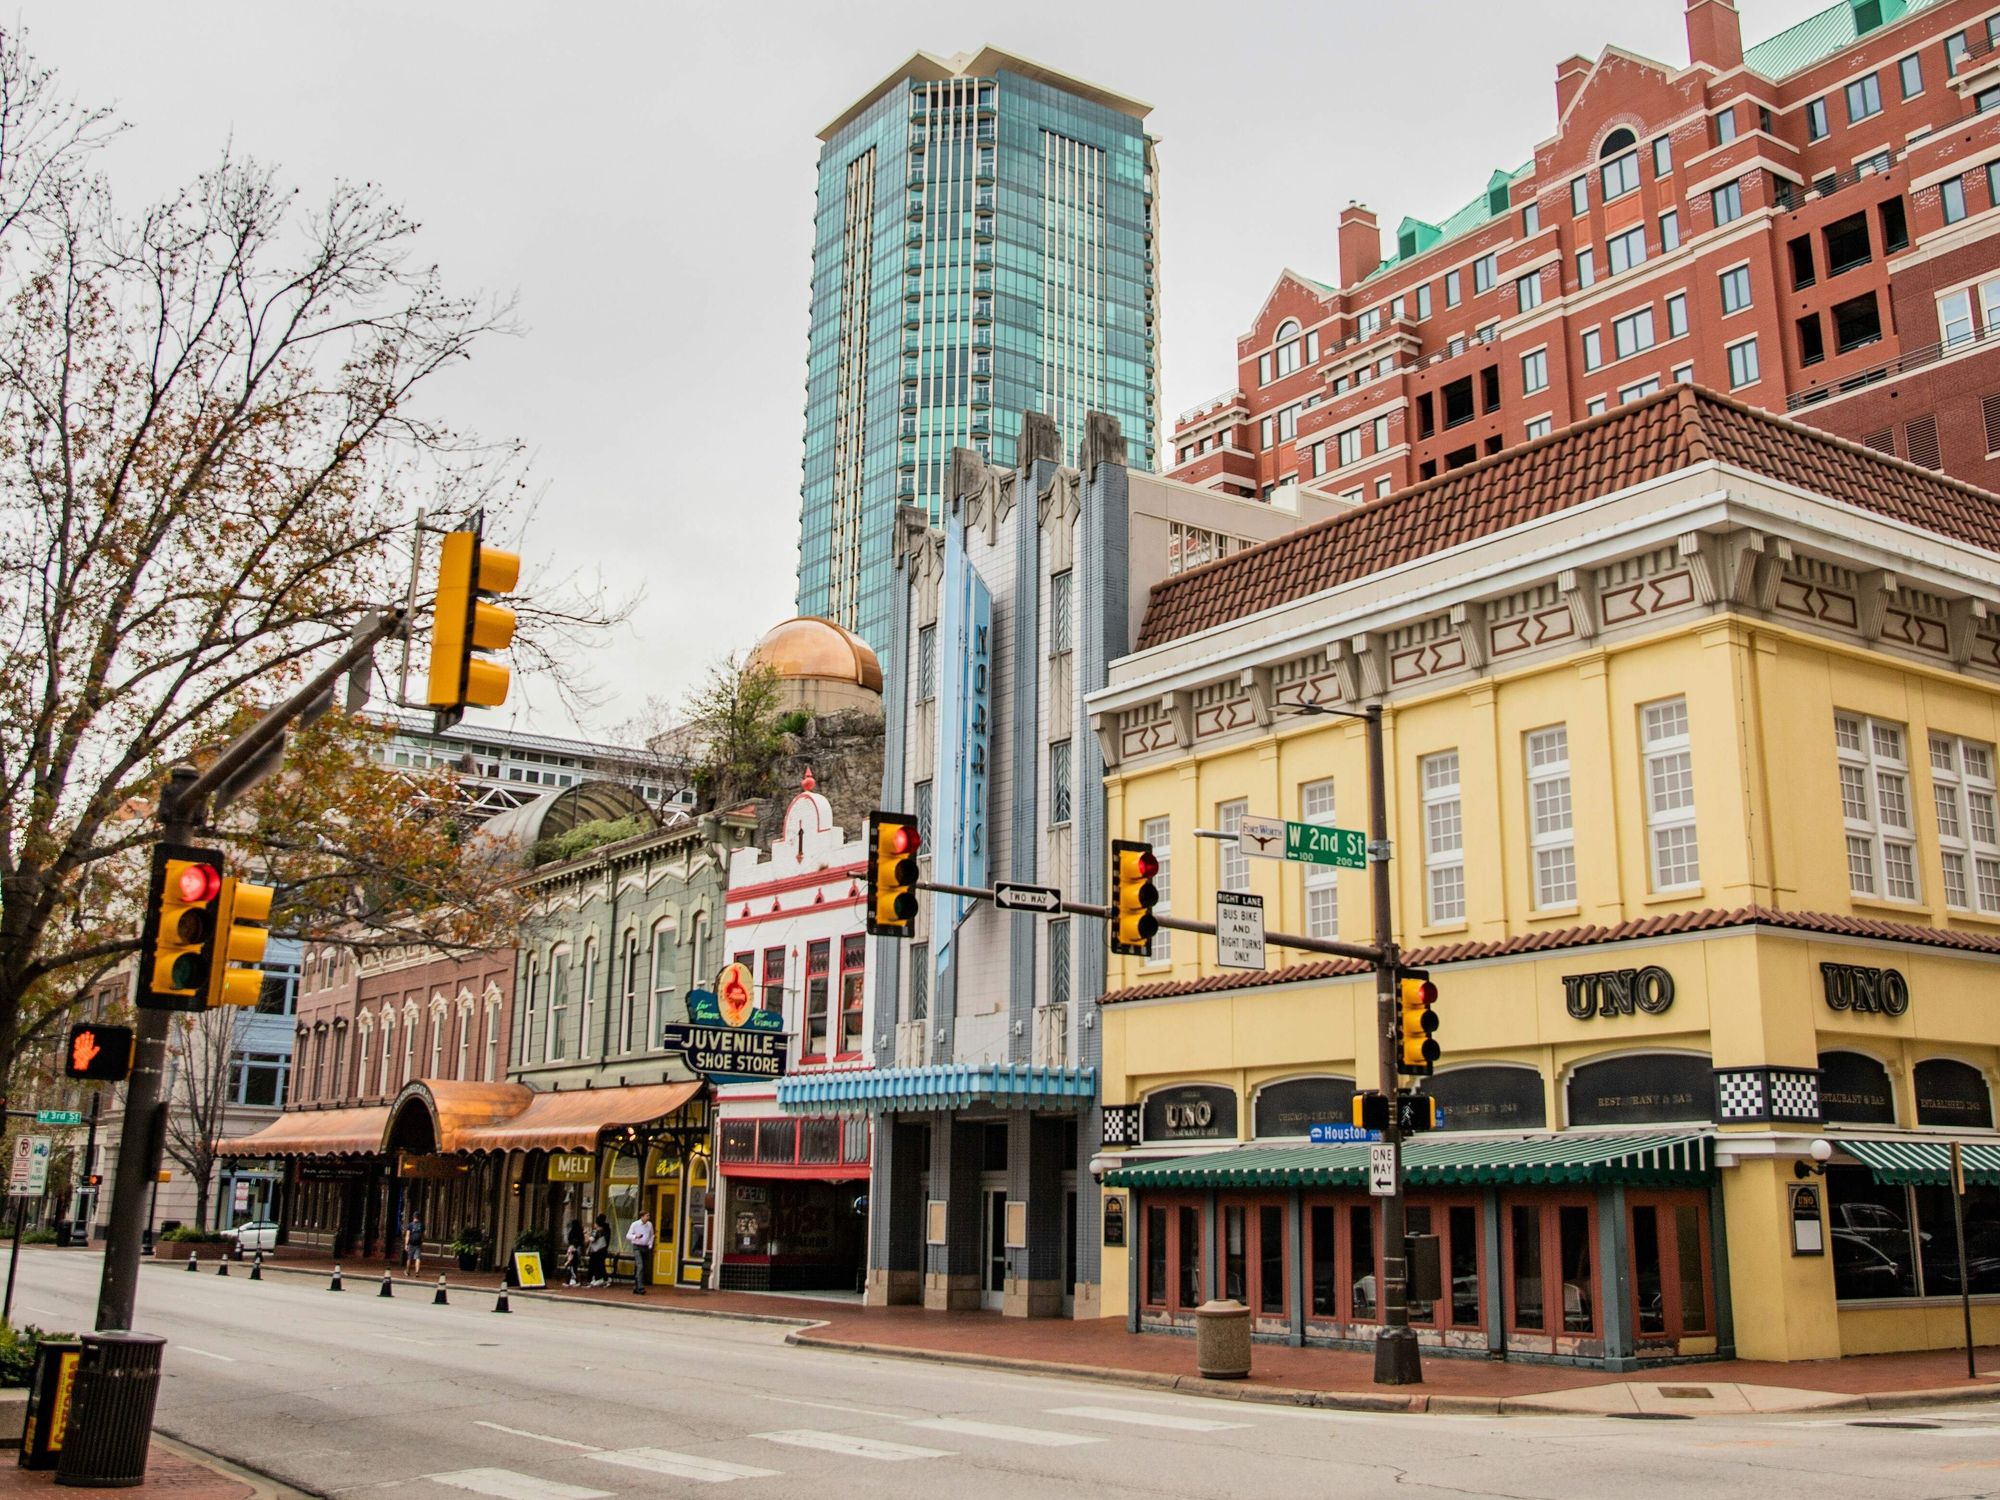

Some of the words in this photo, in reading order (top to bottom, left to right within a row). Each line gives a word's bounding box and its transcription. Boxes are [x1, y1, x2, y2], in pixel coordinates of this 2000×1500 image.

[971, 624, 988, 855] NORRIS
[1289, 825, 1301, 848] W
[1309, 828, 1338, 852] 2nd
[1347, 834, 1364, 856] St
[1300, 852, 1314, 861] 100
[1336, 857, 1352, 866] 200
[1010, 892, 1026, 902] TWO
[1031, 896, 1047, 904] WAY
[1218, 894, 1238, 904] RIGHT
[1242, 896, 1262, 906] LANE
[1223, 909, 1238, 919] BUS
[1241, 911, 1258, 922] BIKE
[1232, 925, 1250, 934] AND
[1221, 937, 1240, 949] RIGHT
[1242, 939, 1262, 951] TURNS
[1234, 950, 1250, 962] ONLY
[1562, 965, 1675, 1020] UNO
[1820, 962, 1909, 1017] UNO
[681, 1029, 774, 1055] JUVENILE
[696, 1051, 732, 1070] SHOE
[737, 1055, 779, 1073] STORE
[50, 1111, 66, 1120] 3rd
[70, 1112, 79, 1120] St
[1165, 1101, 1212, 1129] UNO
[1324, 1125, 1367, 1140] Houston
[1373, 1149, 1392, 1161] ONE
[558, 1155, 591, 1173] MELT
[1373, 1163, 1392, 1175] WAY
[736, 1185, 766, 1200] OPEN
